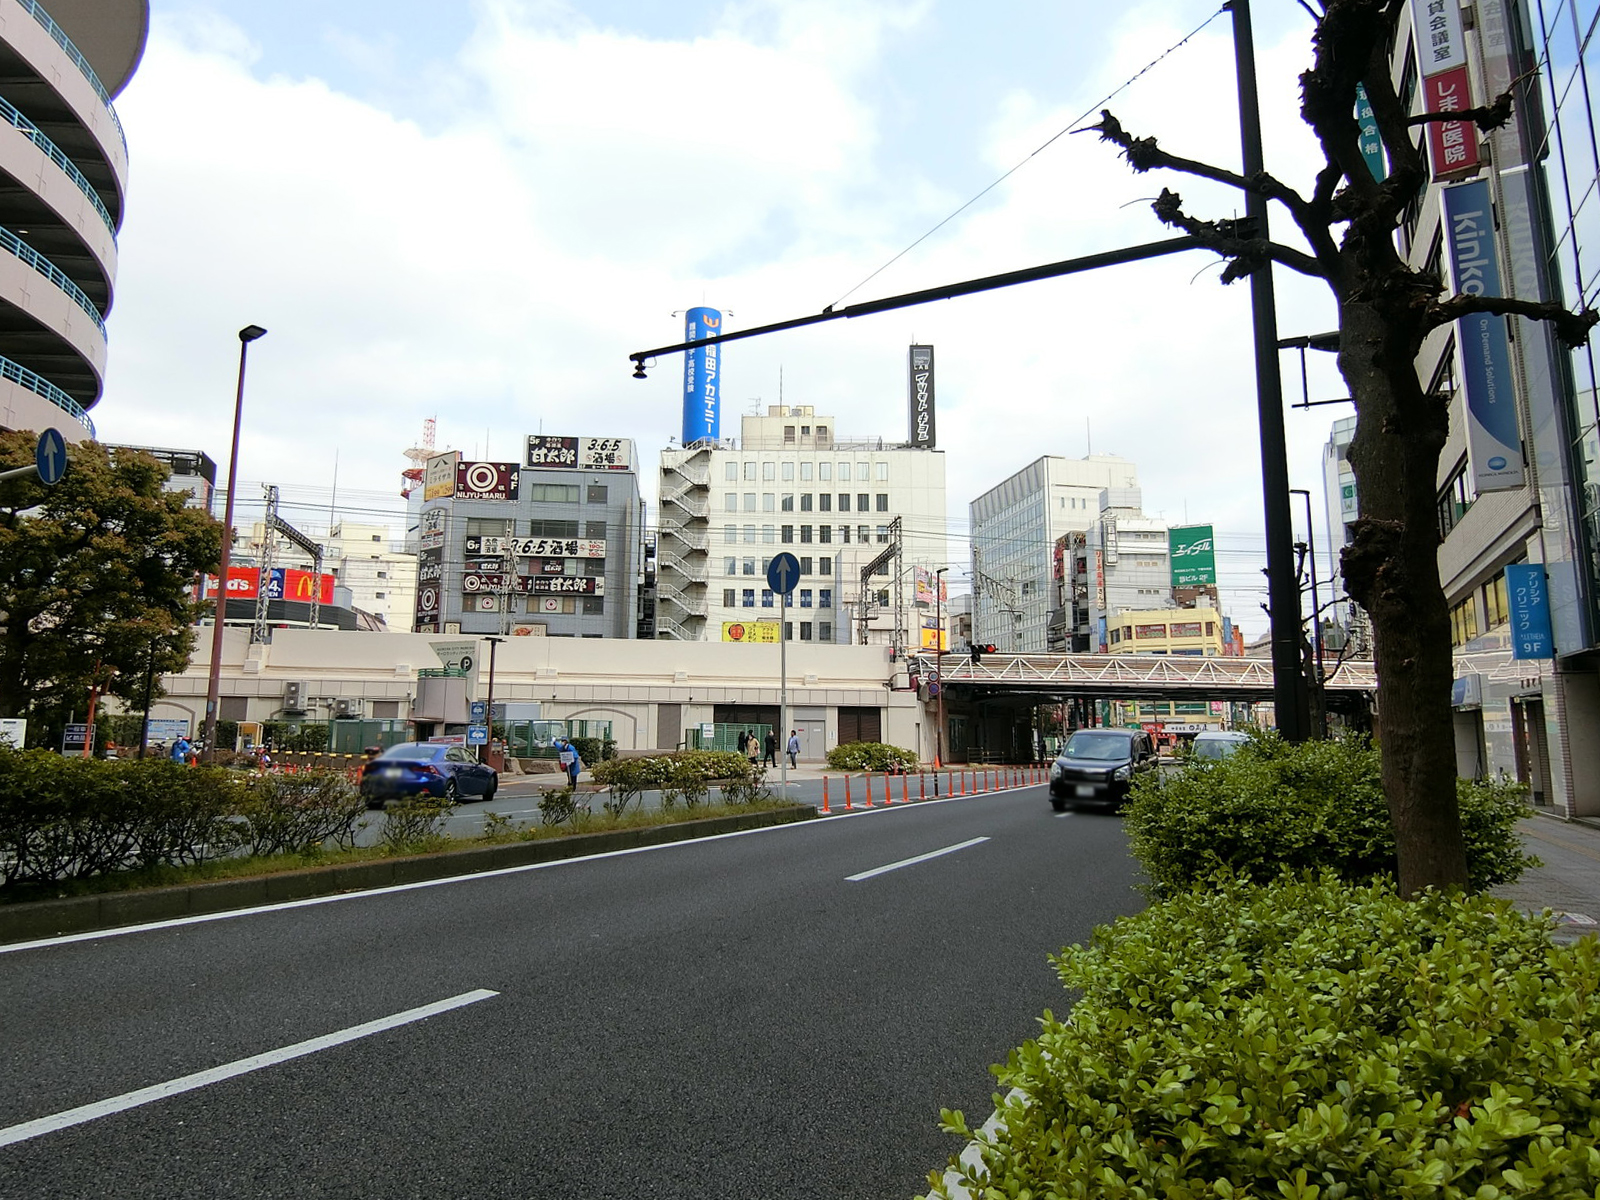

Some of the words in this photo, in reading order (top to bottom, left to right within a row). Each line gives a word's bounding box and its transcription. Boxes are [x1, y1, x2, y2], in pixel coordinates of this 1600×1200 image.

[1480, 319, 1488, 330] On
[1482, 332, 1493, 365] Demand
[1486, 368, 1496, 404] Solutions
[915, 372, 929, 441] マツモトキヨシ
[529, 436, 541, 445] 5F
[531, 447, 576, 465] 甘太郎
[593, 452, 615, 464] 酒場
[456, 491, 506, 499] NIJYU-MARU
[466, 540, 480, 550] 6F
[1172, 538, 1212, 557] エイブル
[550, 577, 588, 592] 甘太郎
[1528, 571, 1540, 606] アリシア
[1516, 587, 1530, 630] クリニック
[1523, 642, 1541, 652] 9F
